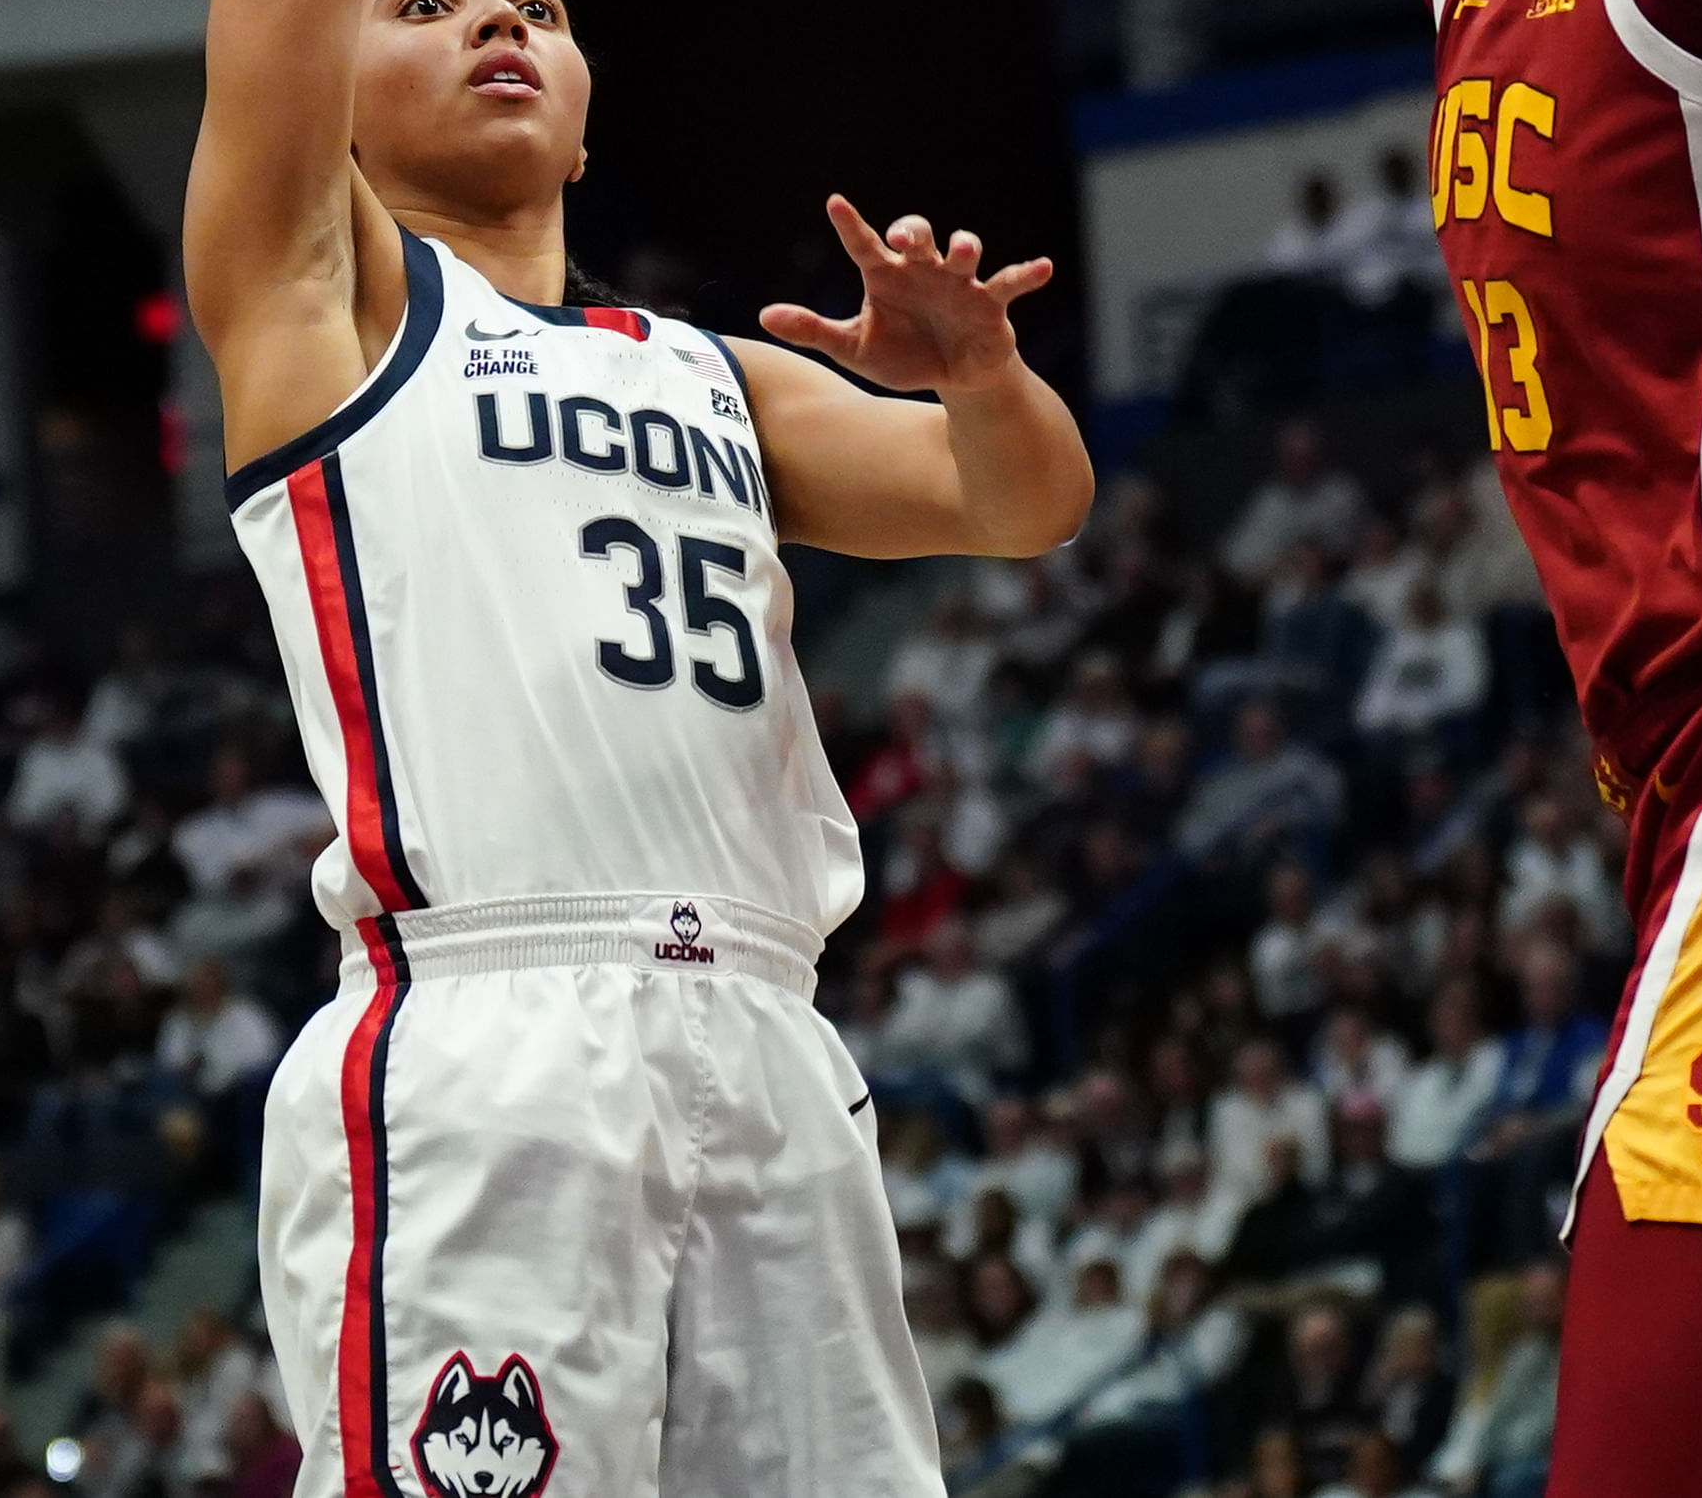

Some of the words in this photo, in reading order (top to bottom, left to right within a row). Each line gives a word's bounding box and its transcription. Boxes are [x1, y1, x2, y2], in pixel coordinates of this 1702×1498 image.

[1432, 77, 1556, 238] USC
[470, 348, 492, 361] BE
[500, 348, 534, 361] THE
[1461, 278, 1553, 452] 13
[463, 361, 539, 378] CHANGE
[710, 388, 738, 409] BIG
[712, 400, 748, 426] EAST
[578, 515, 765, 713] 35
[655, 942, 715, 965] UCONN
